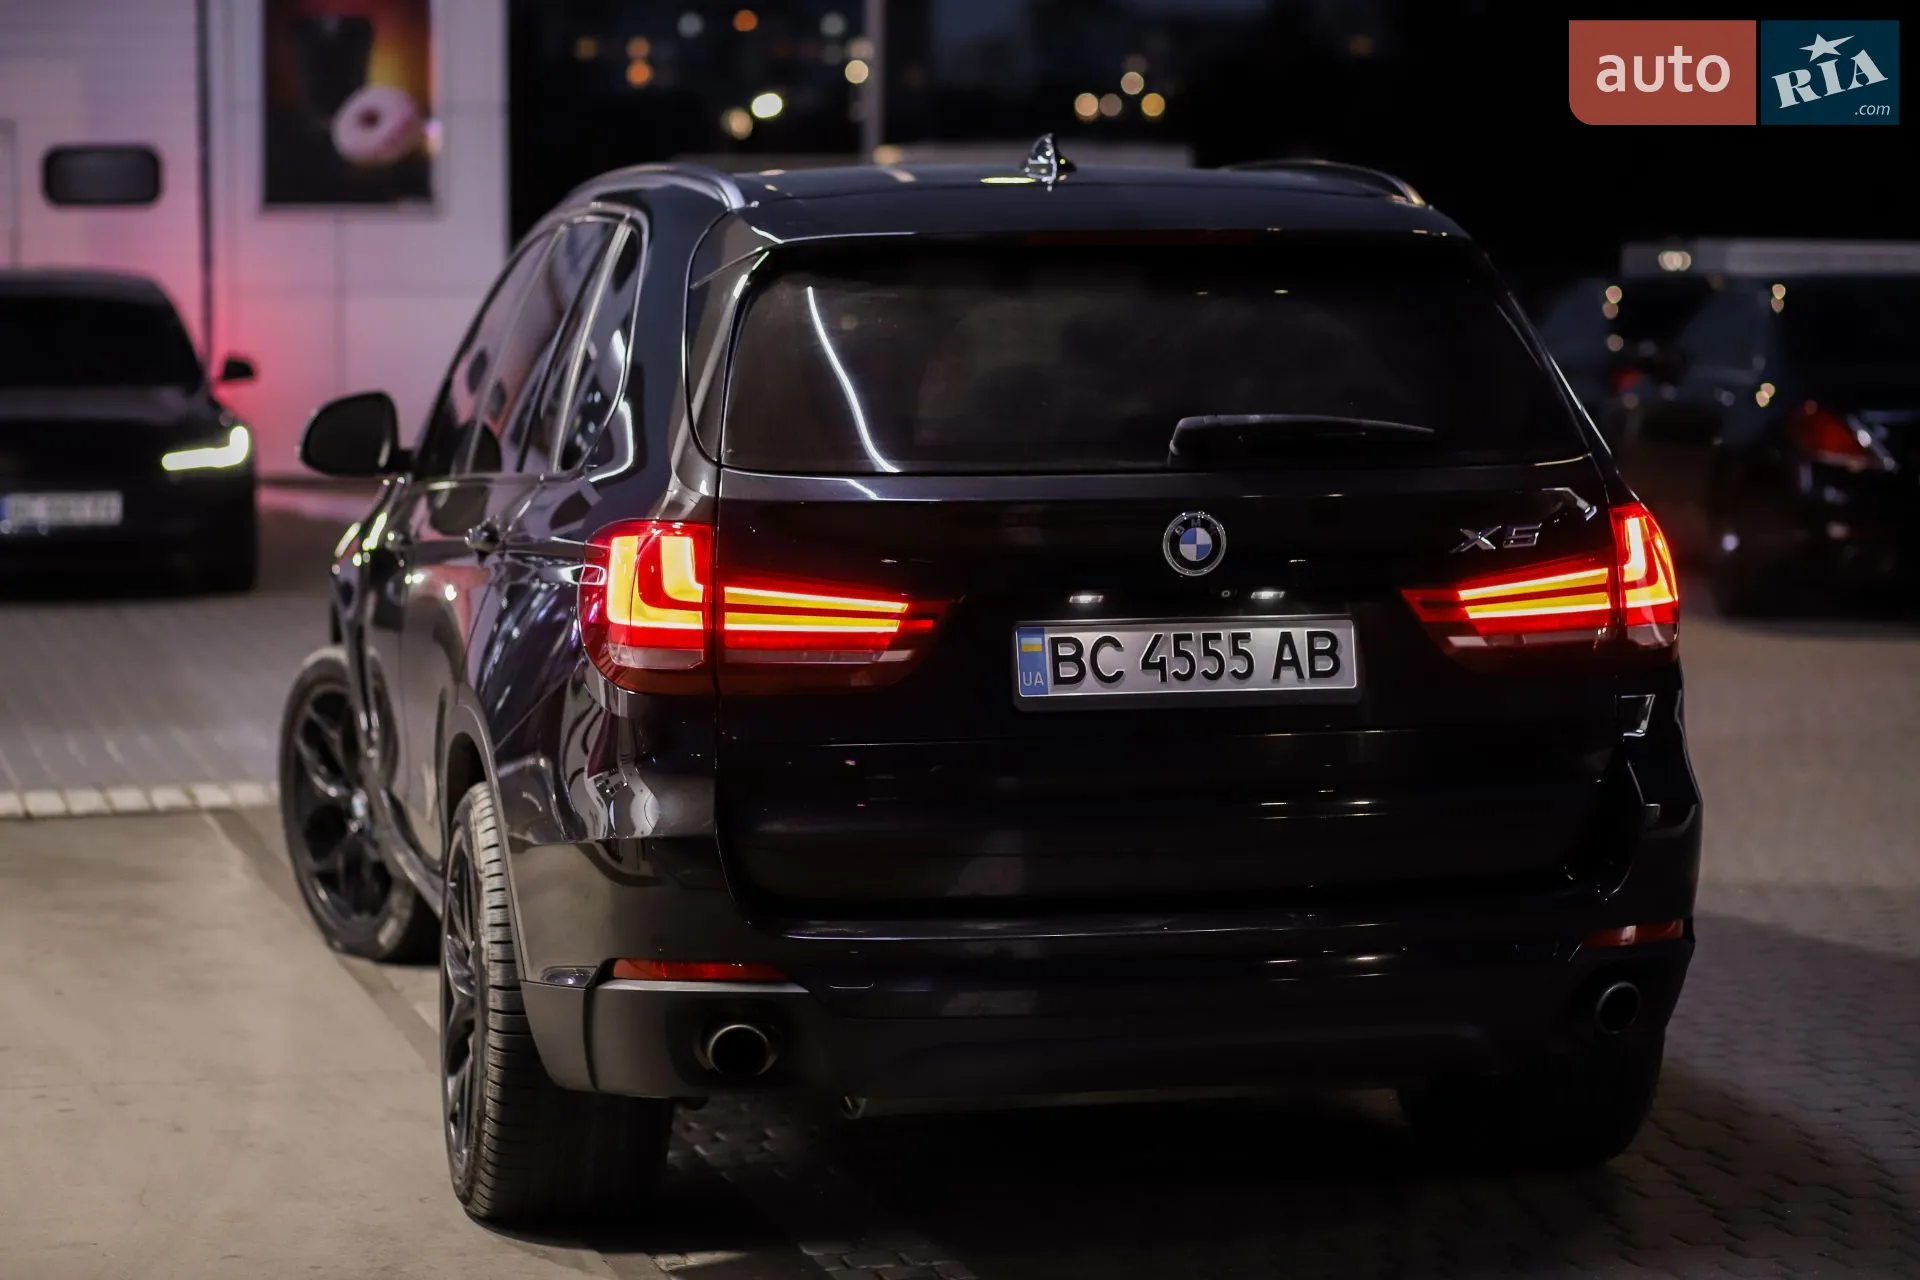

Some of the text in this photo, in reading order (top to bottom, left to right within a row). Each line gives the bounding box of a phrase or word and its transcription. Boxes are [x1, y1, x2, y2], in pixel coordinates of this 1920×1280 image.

[1449, 522, 1544, 555] X5
[1049, 629, 1342, 686] BC 4555 AB
[1022, 671, 1045, 687] UA
